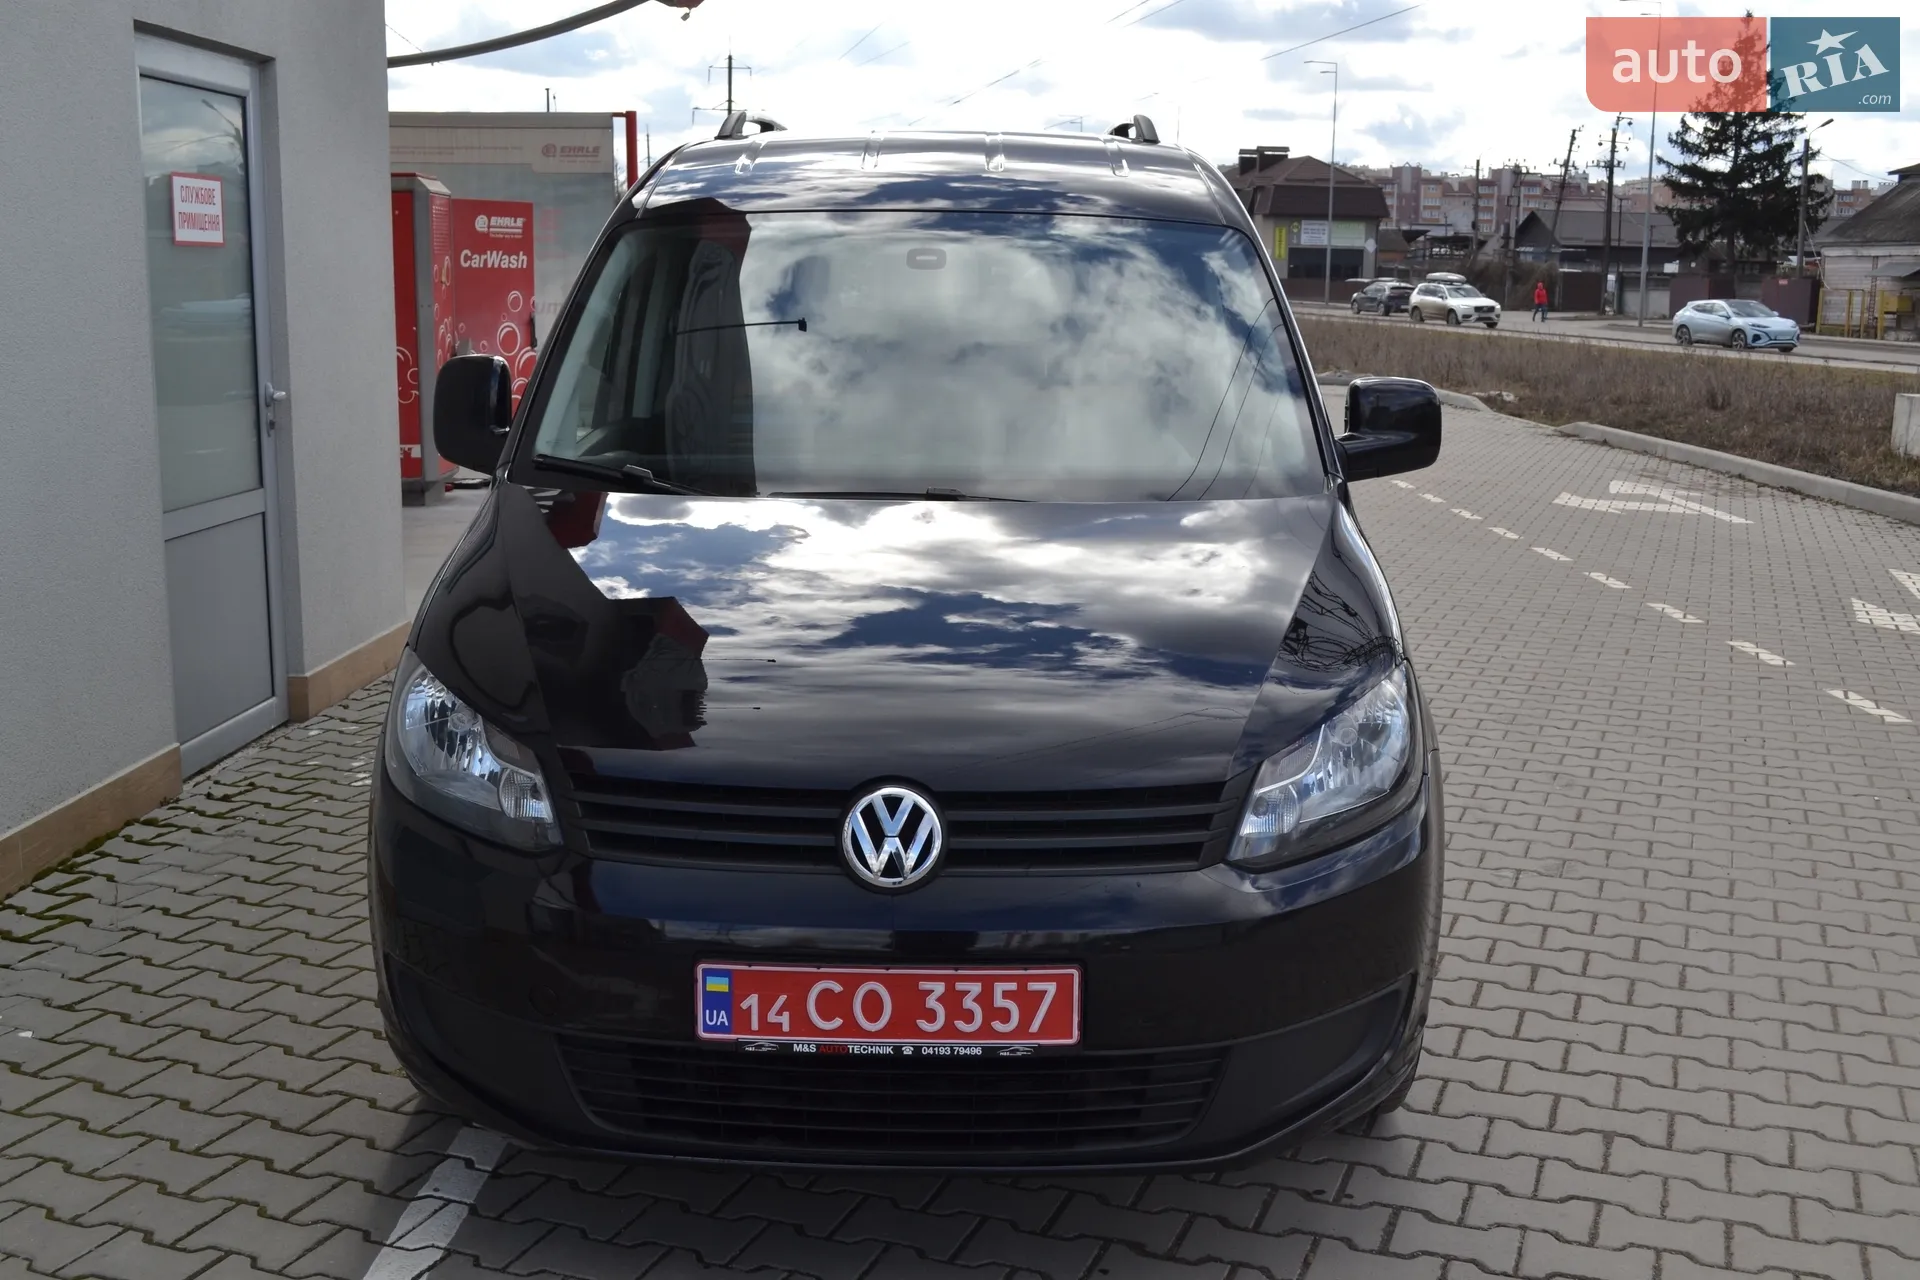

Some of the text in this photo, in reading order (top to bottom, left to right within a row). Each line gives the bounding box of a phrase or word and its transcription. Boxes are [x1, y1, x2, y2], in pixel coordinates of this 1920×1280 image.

[560, 145, 602, 154] EHRLE
[180, 185, 216, 206] СЛУЖБОВЕ
[178, 211, 221, 232] ПРИМІЩЕННЯ
[489, 216, 524, 228] EHRLE
[459, 249, 528, 269] CarWash
[740, 979, 1057, 1033] 14 CO 3357
[705, 1009, 728, 1026] UA
[793, 1043, 817, 1053] M&S
[921, 1046, 951, 1056] 04193
[953, 1046, 982, 1056] 79496
